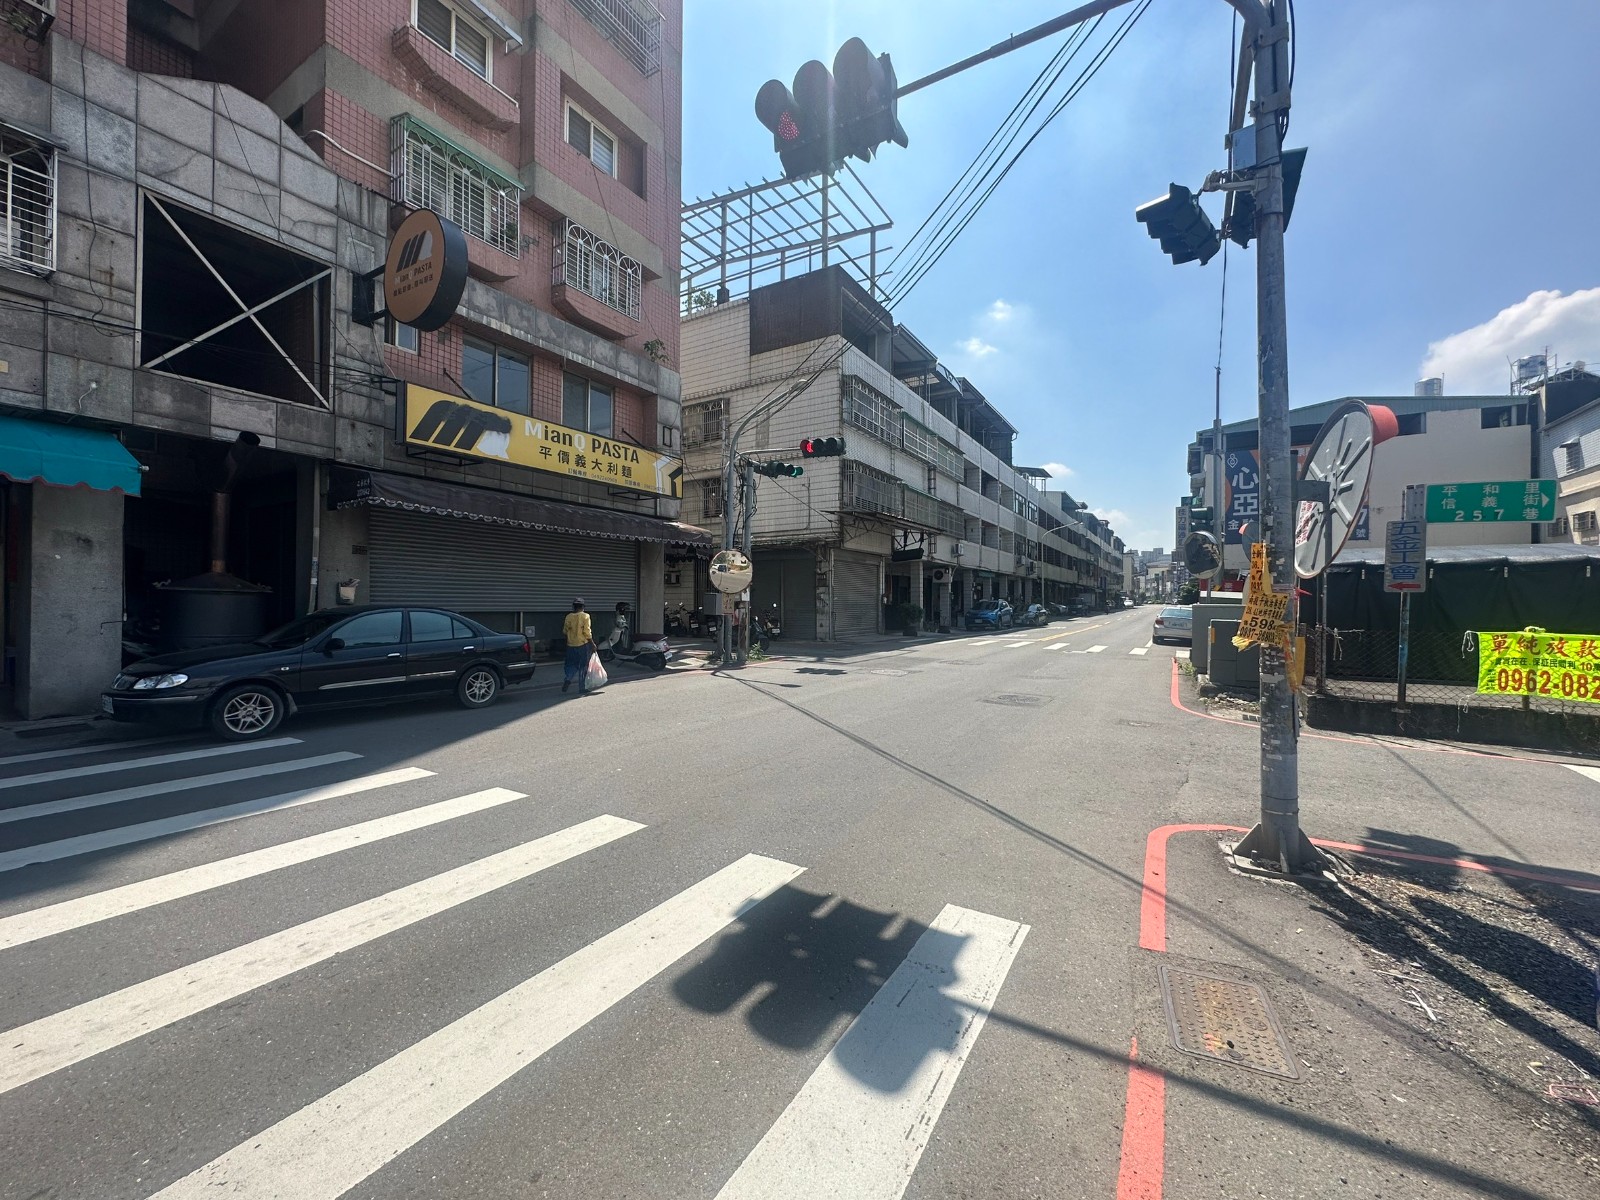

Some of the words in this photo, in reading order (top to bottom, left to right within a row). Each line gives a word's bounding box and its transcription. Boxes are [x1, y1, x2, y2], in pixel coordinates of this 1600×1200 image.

[413, 261, 432, 277] PASTA
[524, 419, 586, 453] MianQ
[591, 437, 640, 465] PASTA
[539, 445, 632, 479] 平價義大利麵
[1441, 481, 1540, 497] 平和里
[1441, 494, 1540, 510] 信義街
[1391, 520, 1421, 580] 五金工會
[1491, 633, 1600, 660] 單純放款
[1497, 667, 1600, 700] 0962-082
